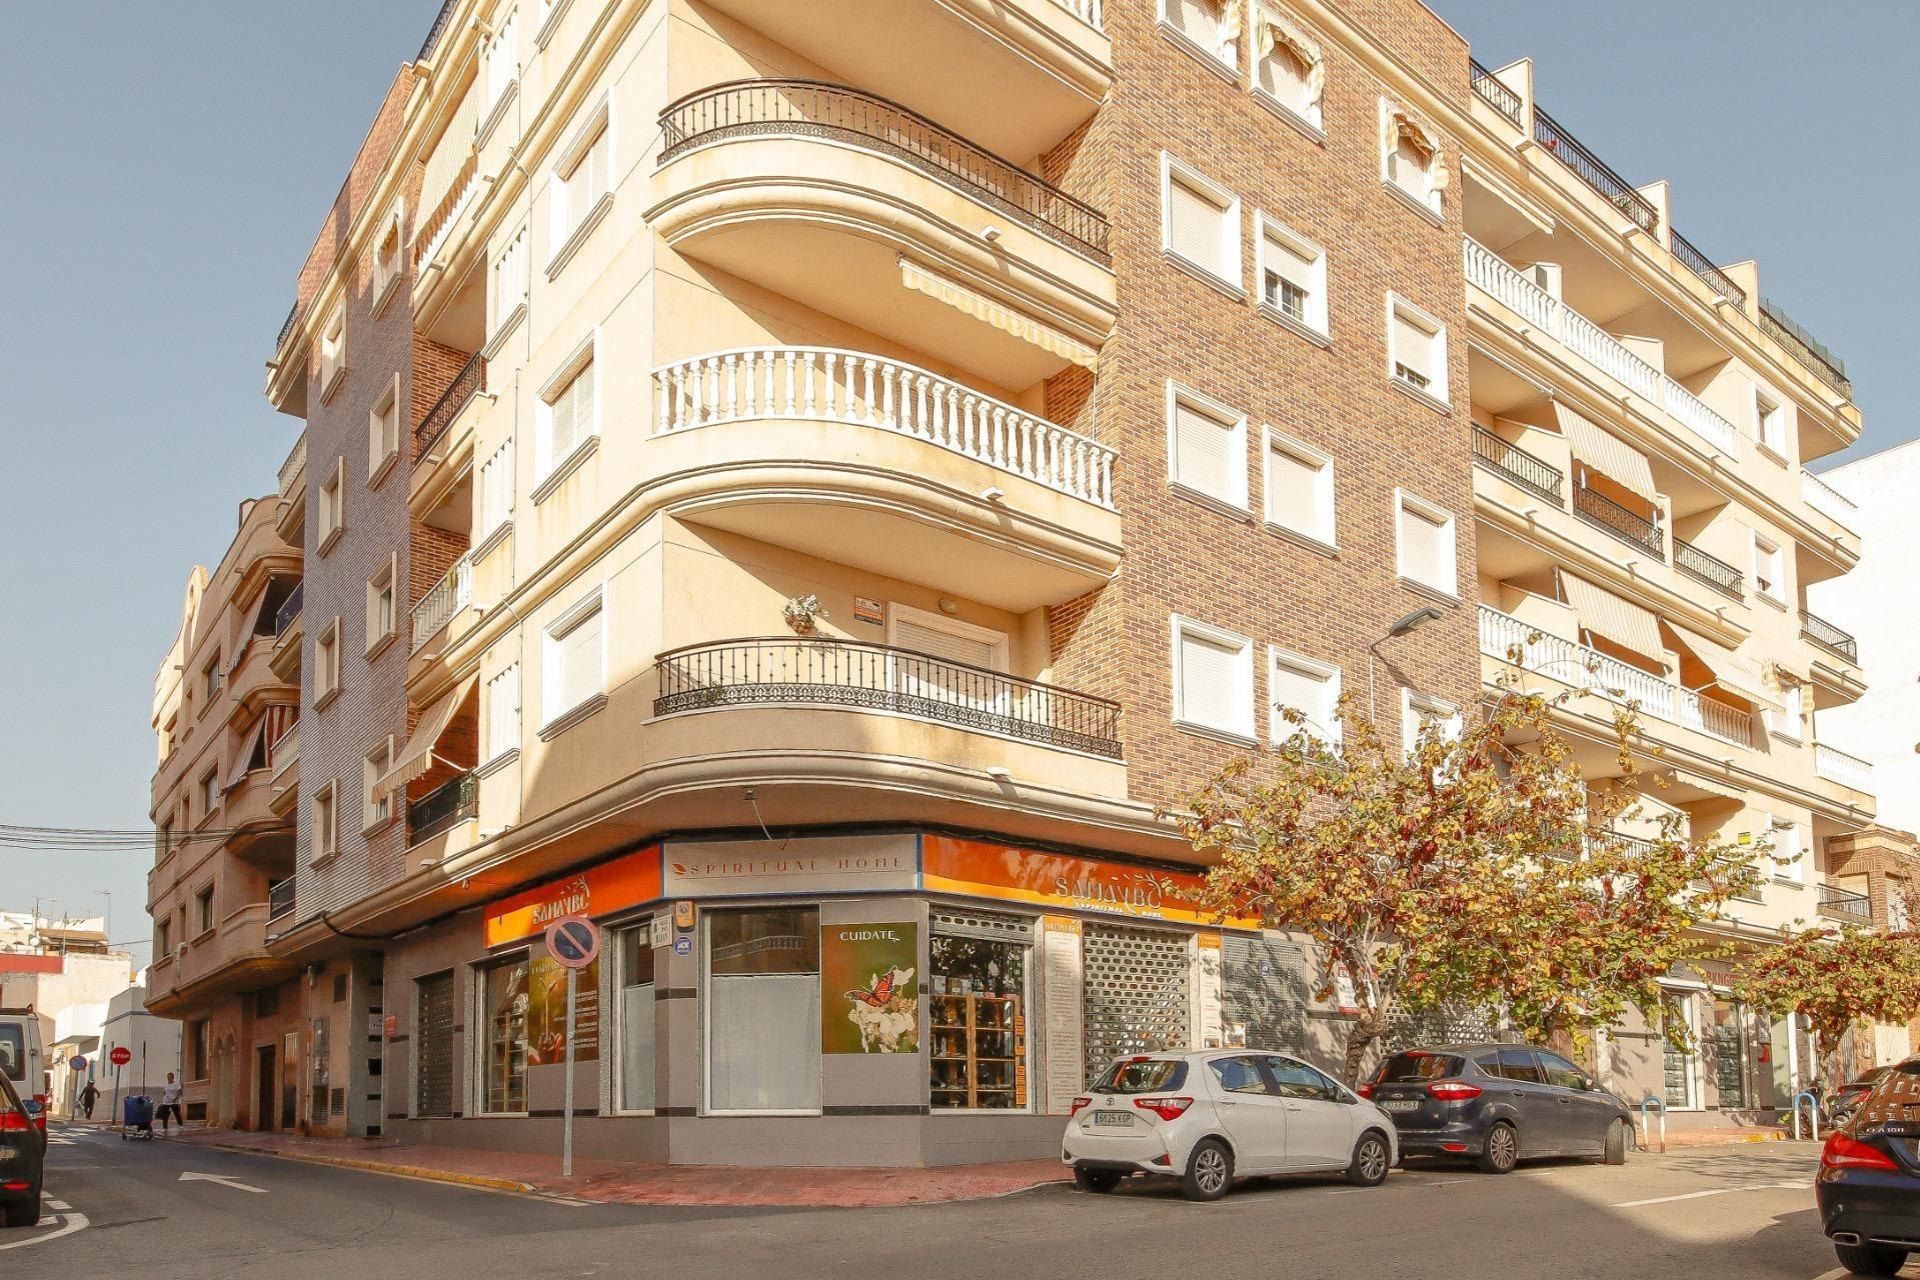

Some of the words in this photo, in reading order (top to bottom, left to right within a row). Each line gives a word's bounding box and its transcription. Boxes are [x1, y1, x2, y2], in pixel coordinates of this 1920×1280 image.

[690, 860, 817, 874] SPIRITUAL
[838, 857, 902, 868] HOME
[1055, 876, 1162, 913] SAMAYBO
[532, 892, 590, 925] SAMAYBO
[840, 930, 895, 941] CUIDATE
